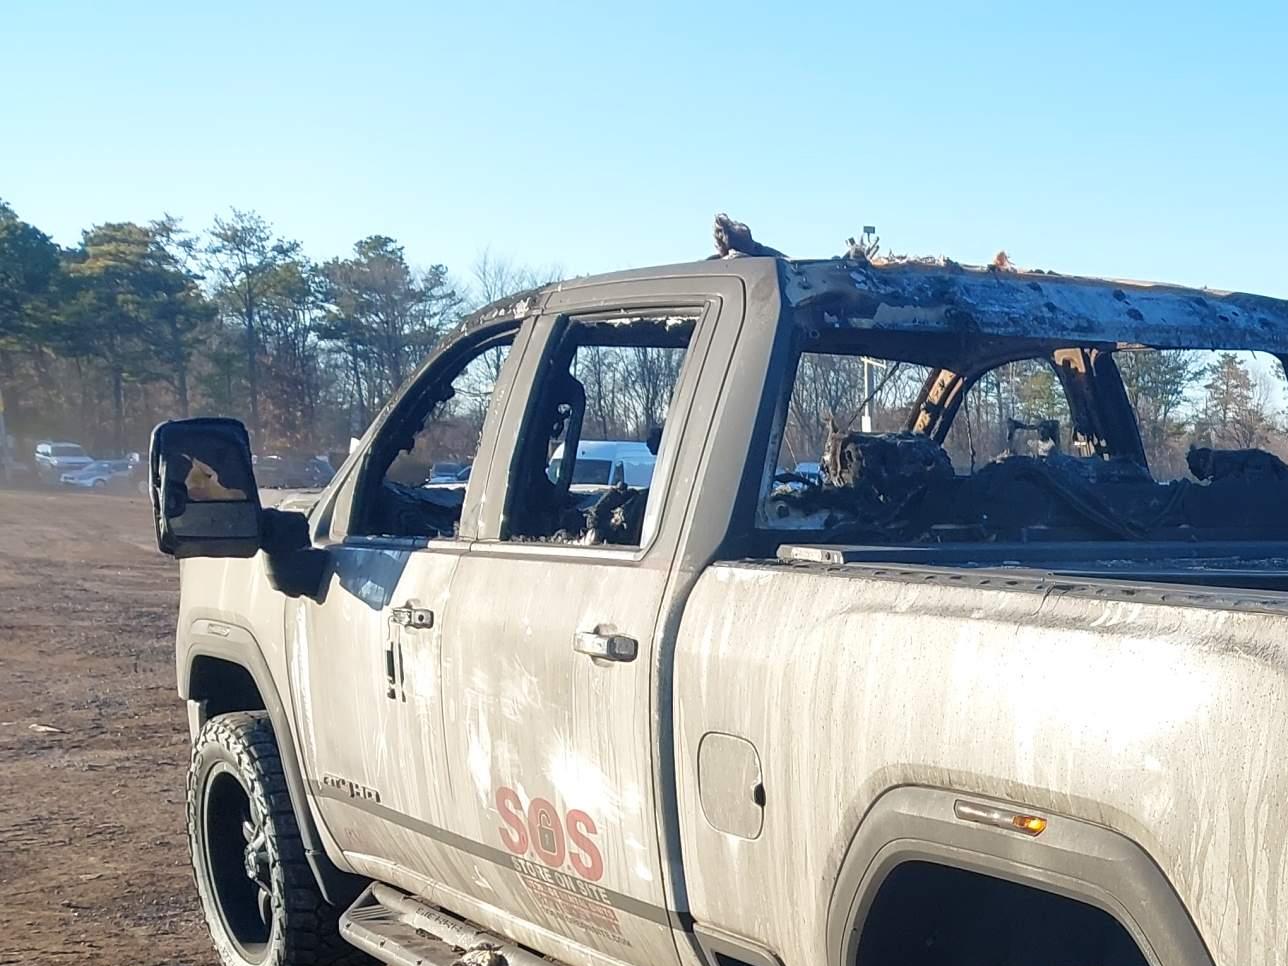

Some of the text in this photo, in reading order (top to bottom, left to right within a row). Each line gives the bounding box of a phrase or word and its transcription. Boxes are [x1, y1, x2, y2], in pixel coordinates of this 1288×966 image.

[495, 786, 604, 882] SOS
[511, 856, 554, 884] STORE
[554, 871, 576, 892] ON
[576, 878, 612, 905] SITE
